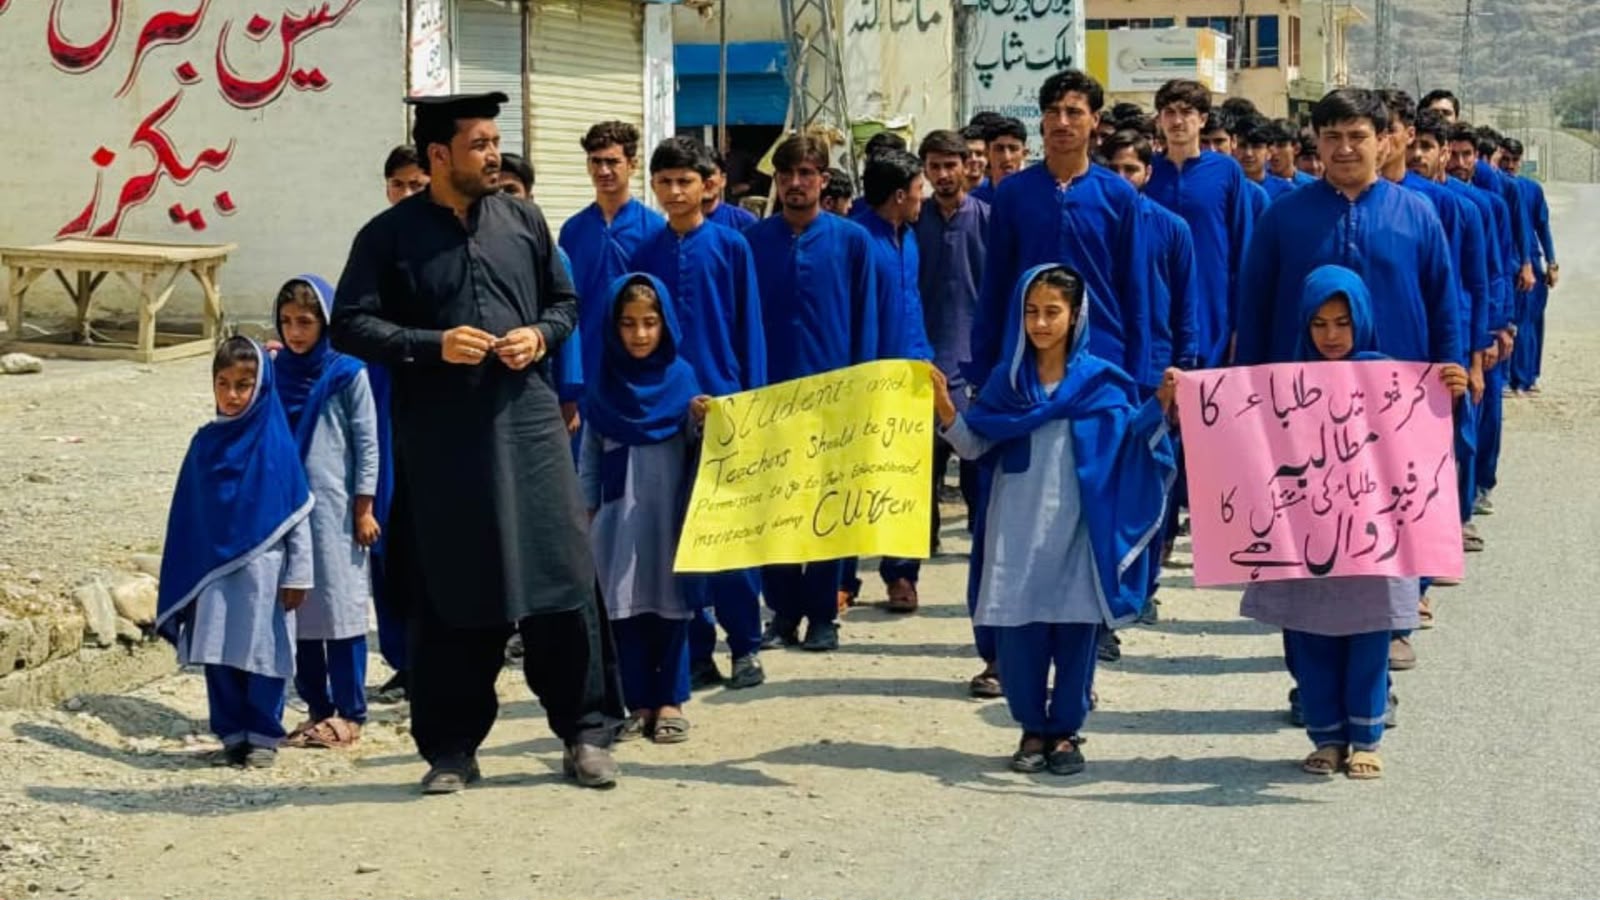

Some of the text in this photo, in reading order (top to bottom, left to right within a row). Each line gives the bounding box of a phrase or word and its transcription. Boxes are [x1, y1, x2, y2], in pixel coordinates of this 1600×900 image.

[214, 0, 359, 107] سین
[973, 32, 1025, 89] شاپ
[53, 88, 236, 240] بیکرز
[717, 373, 908, 447] Students and
[1200, 374, 1226, 426] کا
[705, 449, 792, 493] Teachers
[862, 415, 881, 436] be
[1376, 452, 1449, 523] کرفیو
[1220, 486, 1238, 524] کا
[1311, 464, 1334, 516] کی
[1304, 510, 1404, 577] زوال
